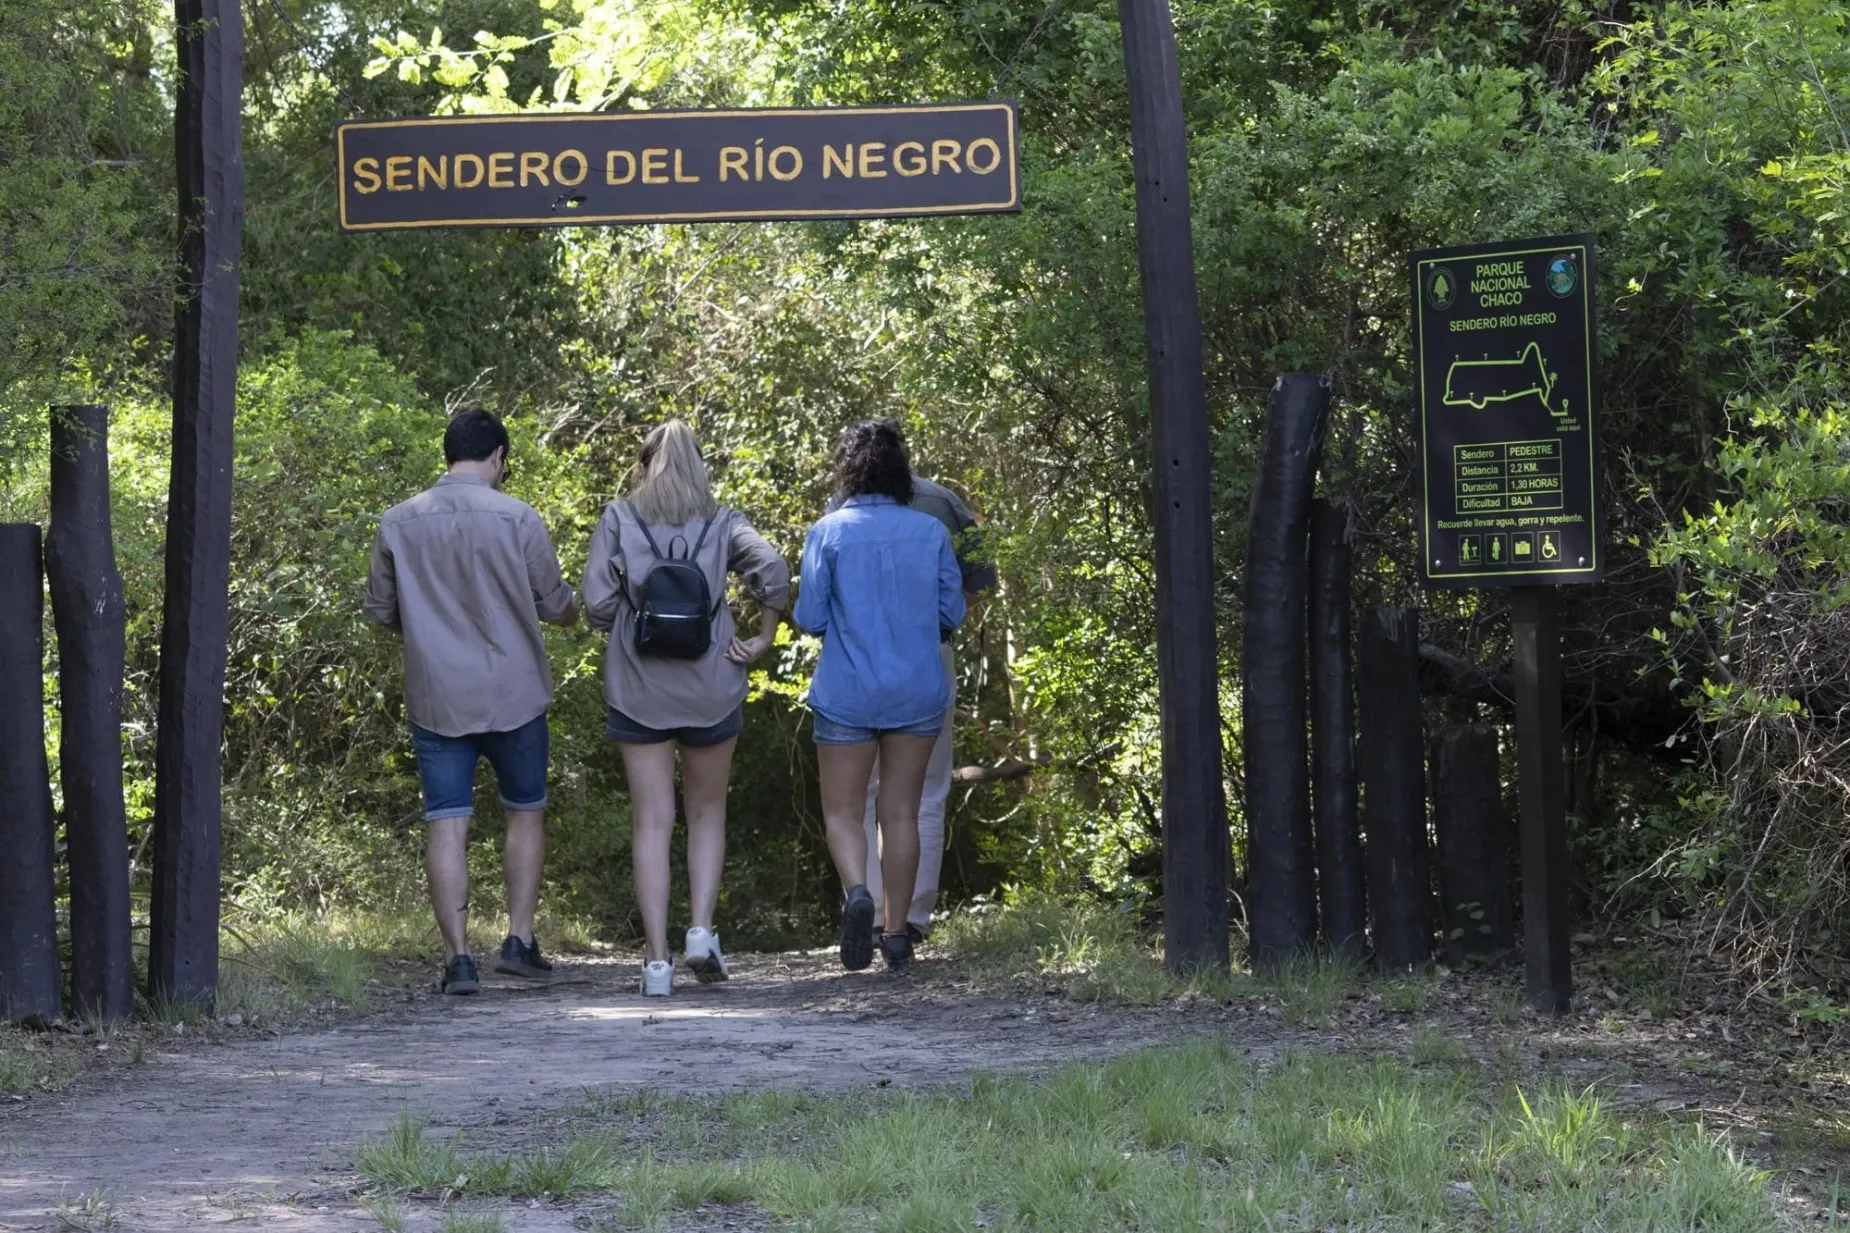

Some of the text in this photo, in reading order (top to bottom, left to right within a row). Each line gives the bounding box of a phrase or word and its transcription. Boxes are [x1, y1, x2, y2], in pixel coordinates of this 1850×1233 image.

[353, 138, 1001, 195] SENDERO DEL RÍO NEGRO
[1476, 261, 1524, 278] PARQUE
[1471, 276, 1531, 293] NACIONAL
[1480, 291, 1522, 307] CHACO
[1450, 317, 1498, 332] SENDERO
[1519, 312, 1556, 326] NEGRO
[1461, 445, 1553, 459] Sendero PEDESTRE
[1461, 462, 1539, 476] Distancia 2,2 KM.
[1462, 478, 1559, 493] Duración 1,30 HORAS
[1463, 496, 1533, 509] Dificultad BAJA
[1437, 518, 1473, 529] Recuerde
[1474, 517, 1495, 526] llevar
[1495, 517, 1517, 527] agua,
[1518, 516, 1539, 527] gorra
[1546, 513, 1584, 524] repelente.
